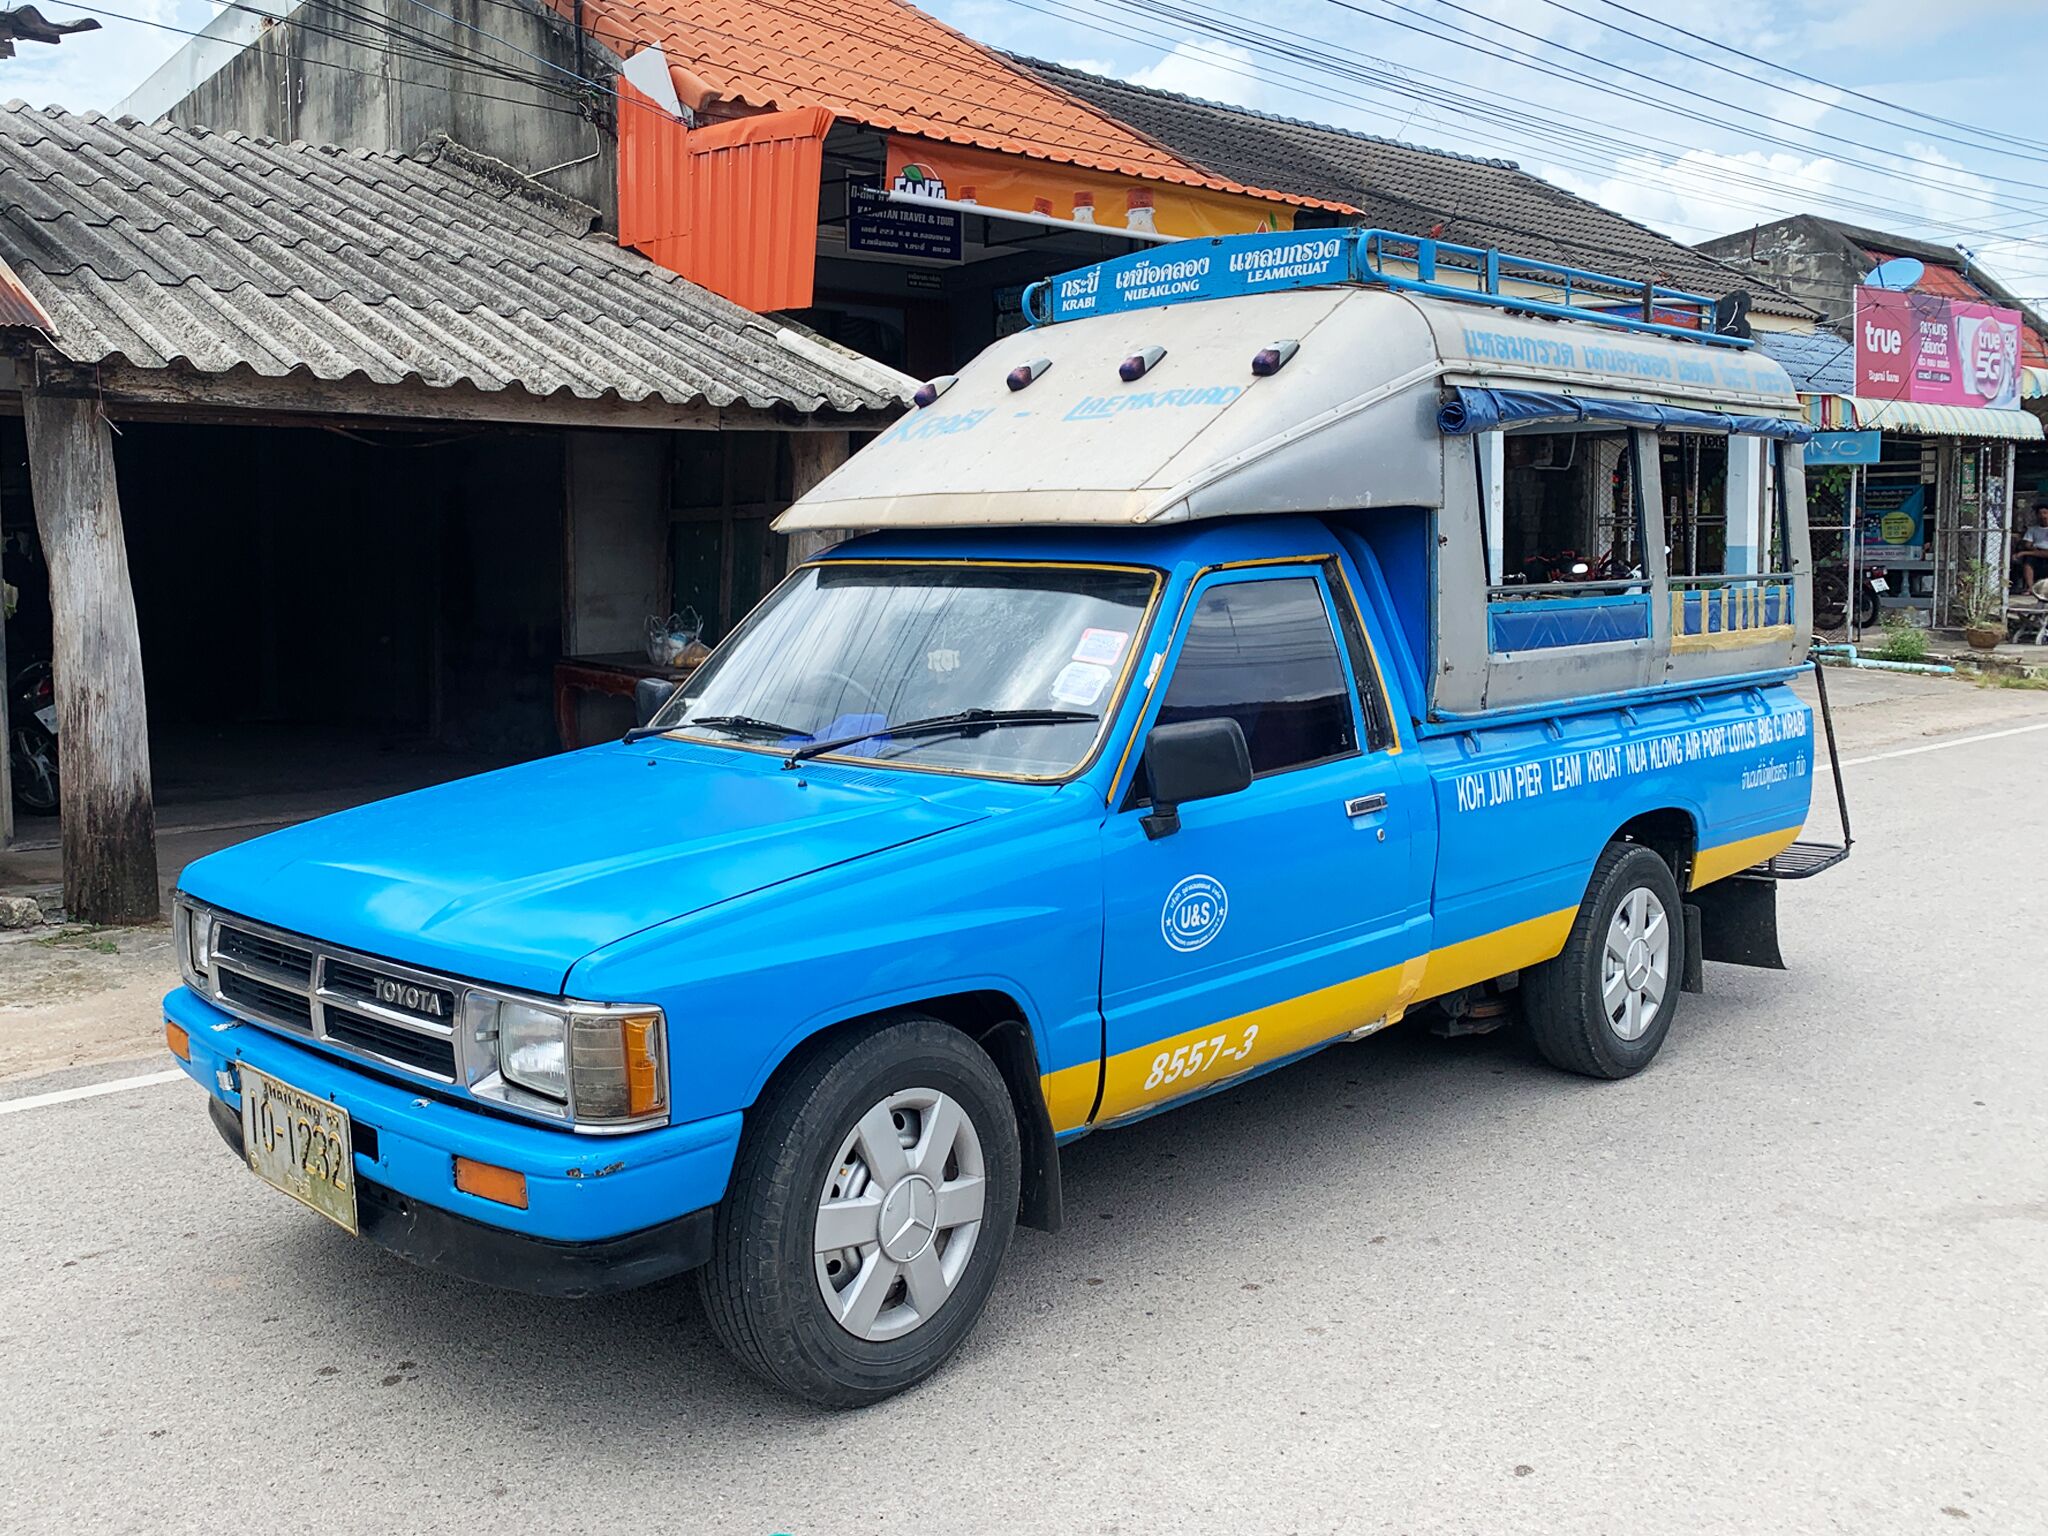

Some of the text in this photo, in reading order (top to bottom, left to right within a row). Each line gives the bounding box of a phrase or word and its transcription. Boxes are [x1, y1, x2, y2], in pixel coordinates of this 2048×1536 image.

[894, 178, 946, 200] FANTA
[900, 210, 927, 225] TRAVEL
[927, 214, 936, 225] &
[936, 215, 955, 227] TOUR
[1061, 238, 1341, 298] กระบี่ เหนือคลอง แหลมกรวด
[1062, 260, 1330, 312] KRABI NUEAKLONG LEAMKRUAT
[1865, 320, 1902, 355] true
[1978, 328, 2001, 350] true
[1975, 350, 2001, 380] 5G
[1456, 710, 1806, 812] KOH JUM PIER LEAM KRUAT NUA KLONG AIR PORT LOTUS BIG C KRABI
[1181, 902, 1210, 929] U&S
[374, 977, 443, 1016] TOYOTA
[1144, 1024, 1259, 1091] 8557-3
[250, 1089, 346, 1192] 10-1232
